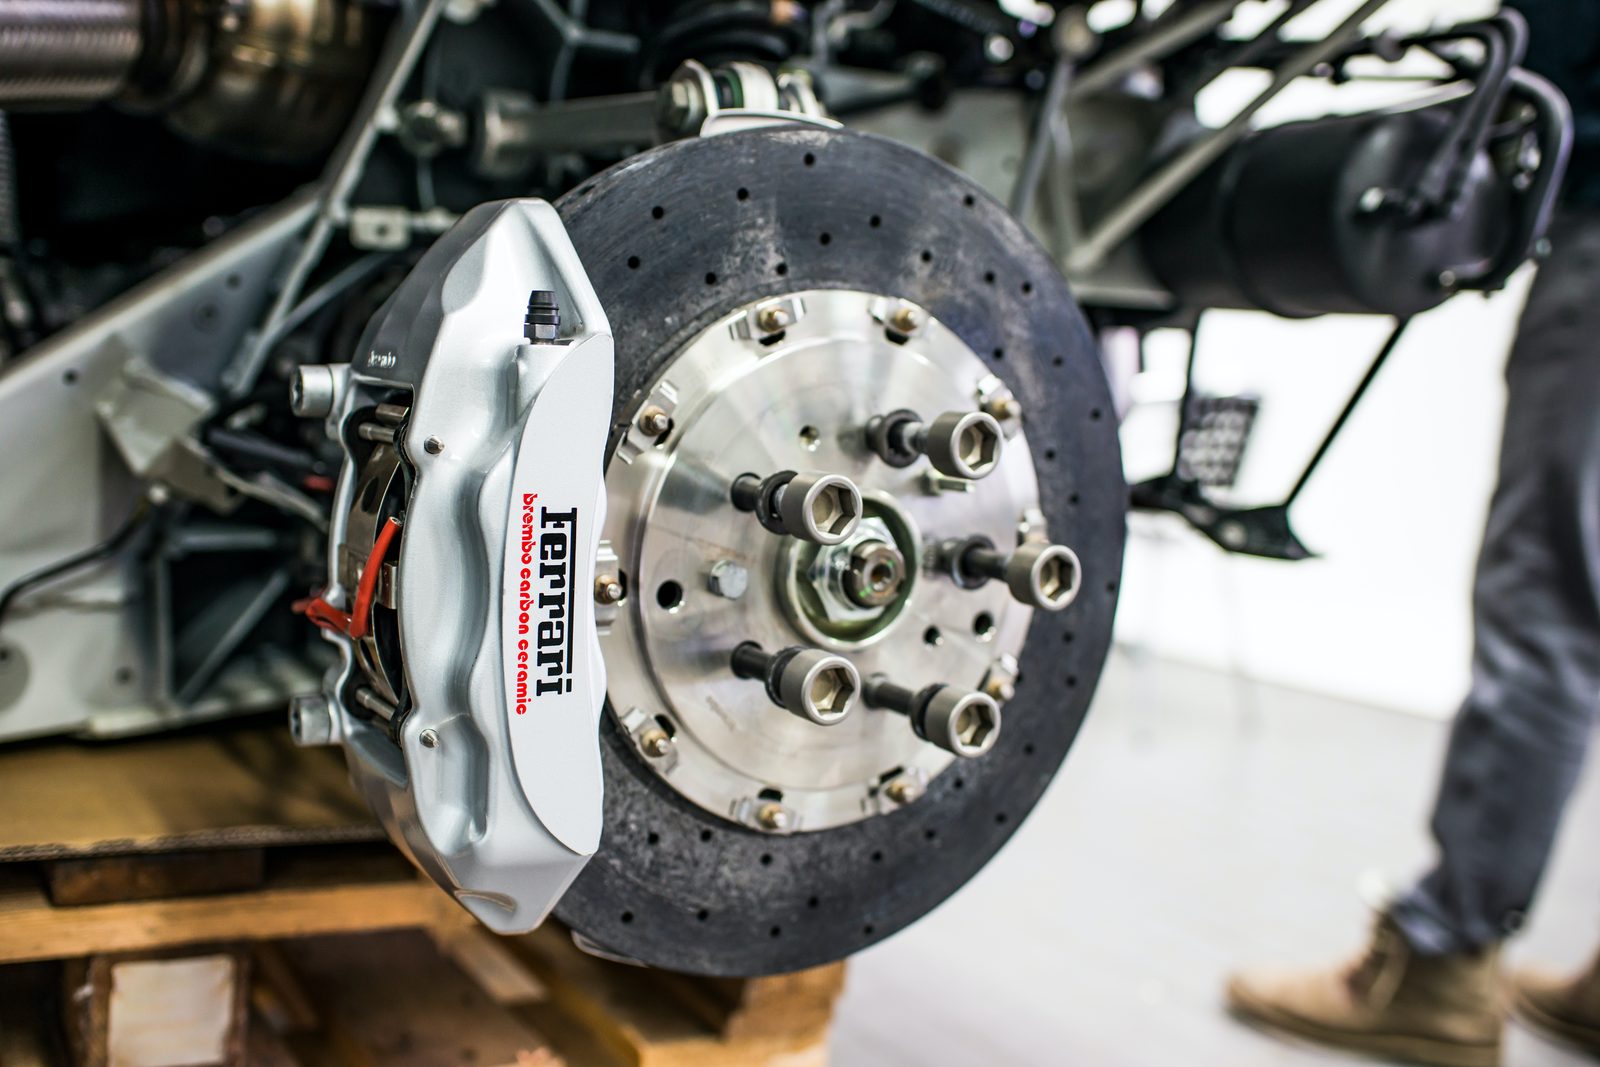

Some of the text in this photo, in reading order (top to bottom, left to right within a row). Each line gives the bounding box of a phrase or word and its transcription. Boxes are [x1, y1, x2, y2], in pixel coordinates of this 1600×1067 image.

[516, 493, 537, 715] brembo carbon ceramic
[536, 507, 577, 697] Ferrari
